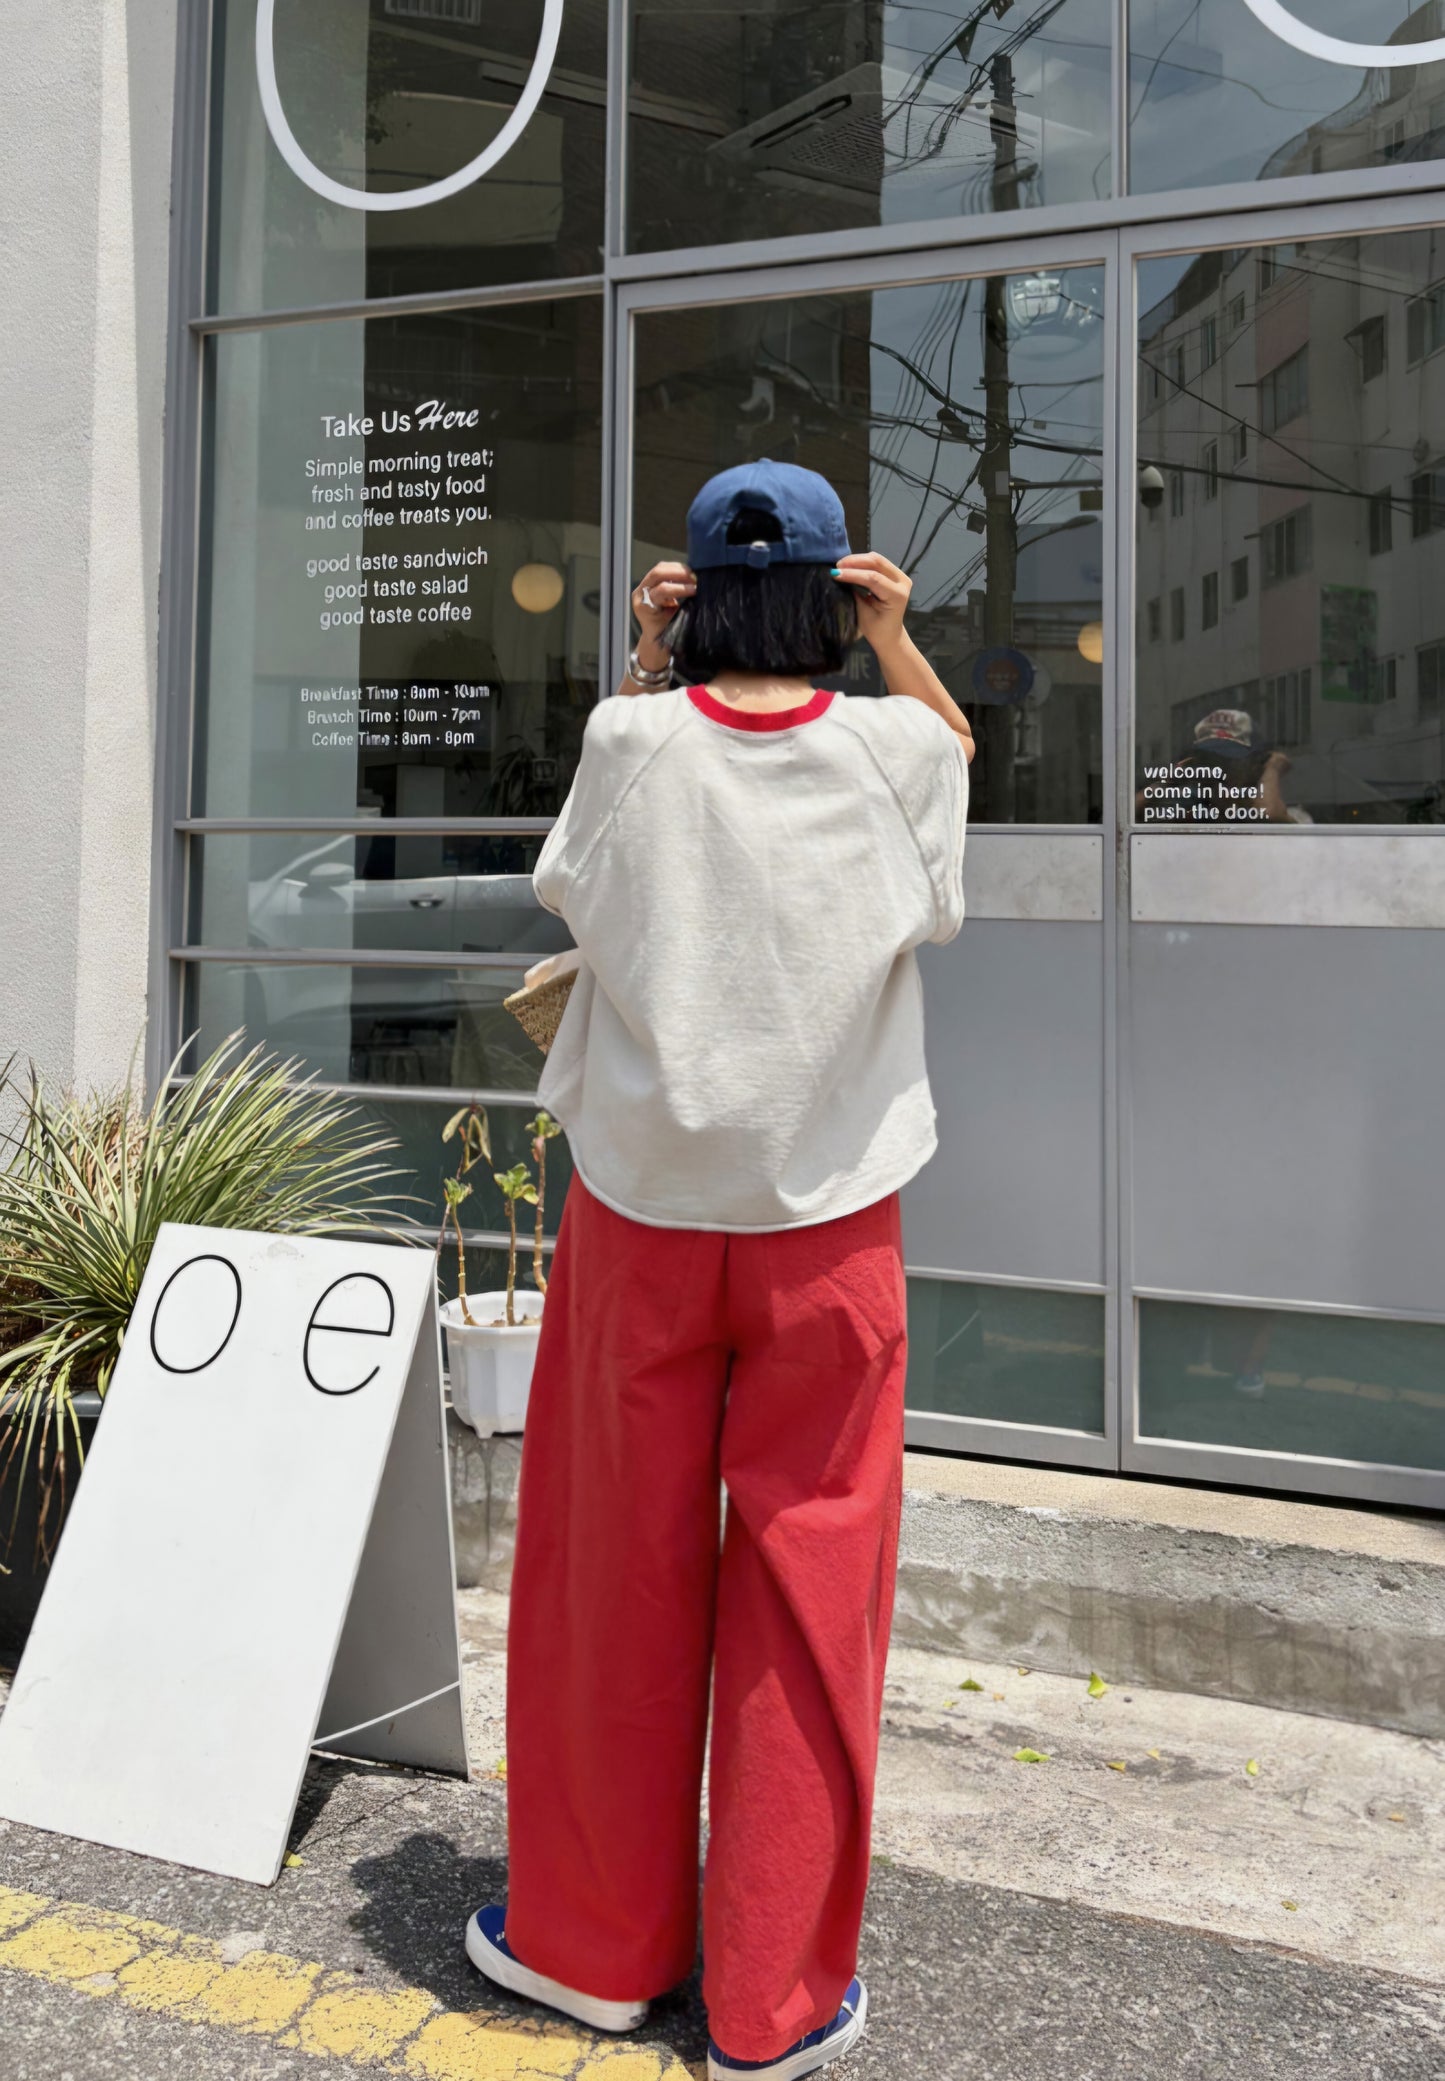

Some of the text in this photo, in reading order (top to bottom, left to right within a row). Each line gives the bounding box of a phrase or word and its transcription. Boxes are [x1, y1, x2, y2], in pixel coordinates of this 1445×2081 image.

[320, 400, 479, 438] Take Us Here
[304, 456, 363, 479] Simple
[368, 451, 441, 474] morning
[311, 474, 486, 503] fresh and tasty food
[305, 505, 492, 531] and coffee treats you.
[306, 546, 489, 578] good taste sandwich
[324, 574, 469, 604] good taste salad
[320, 602, 473, 630] good taste coffee
[301, 687, 362, 702] Breakfast
[365, 686, 399, 700] Time
[307, 710, 354, 724] Brunch
[358, 709, 392, 723] Time
[451, 708, 481, 723] 7pm
[312, 732, 354, 746] Coffee
[358, 732, 391, 746] Time
[445, 731, 475, 747] 8pm
[1144, 763, 1227, 780] welcome,
[1144, 783, 1264, 799] come in here!
[1144, 804, 1186, 822] push
[1192, 804, 1220, 820] the
